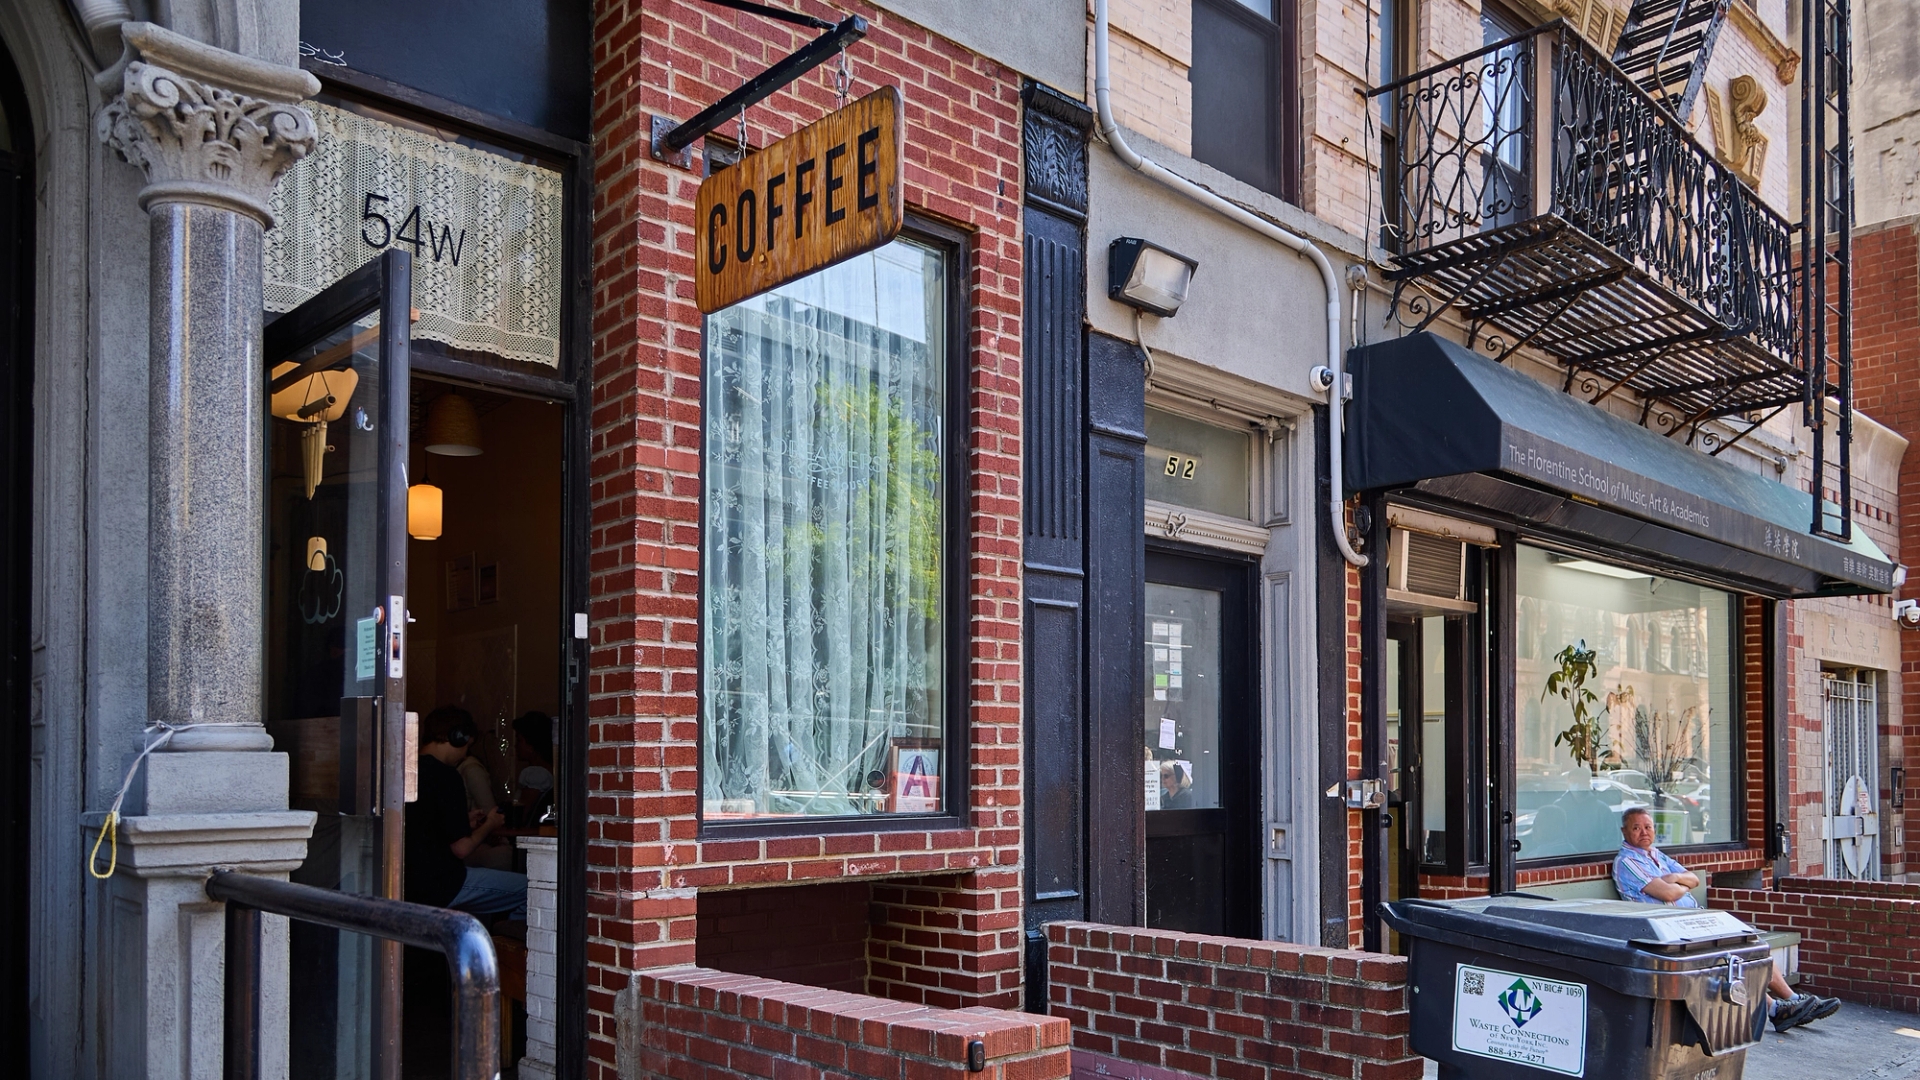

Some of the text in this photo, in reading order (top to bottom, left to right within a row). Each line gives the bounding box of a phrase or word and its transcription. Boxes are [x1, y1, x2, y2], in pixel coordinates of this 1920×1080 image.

[708, 126, 879, 275] COFFEE
[834, 478, 869, 490] OUSE
[1509, 444, 1526, 465] The
[1527, 448, 1577, 482] Florentine
[1578, 467, 1609, 494] School
[1610, 481, 1621, 501] of
[1621, 483, 1647, 509] Music,
[1648, 493, 1662, 512] Art
[1662, 497, 1669, 514] &
[1670, 500, 1710, 528] Academics
[1165, 511, 1188, 537] 52
[902, 755, 931, 798] A
[1532, 981, 1583, 998] NY BIC# 1059
[1469, 1018, 1570, 1046] WASTE CONNECTIONS
[1487, 1045, 1546, 1064] 888-437-4271
